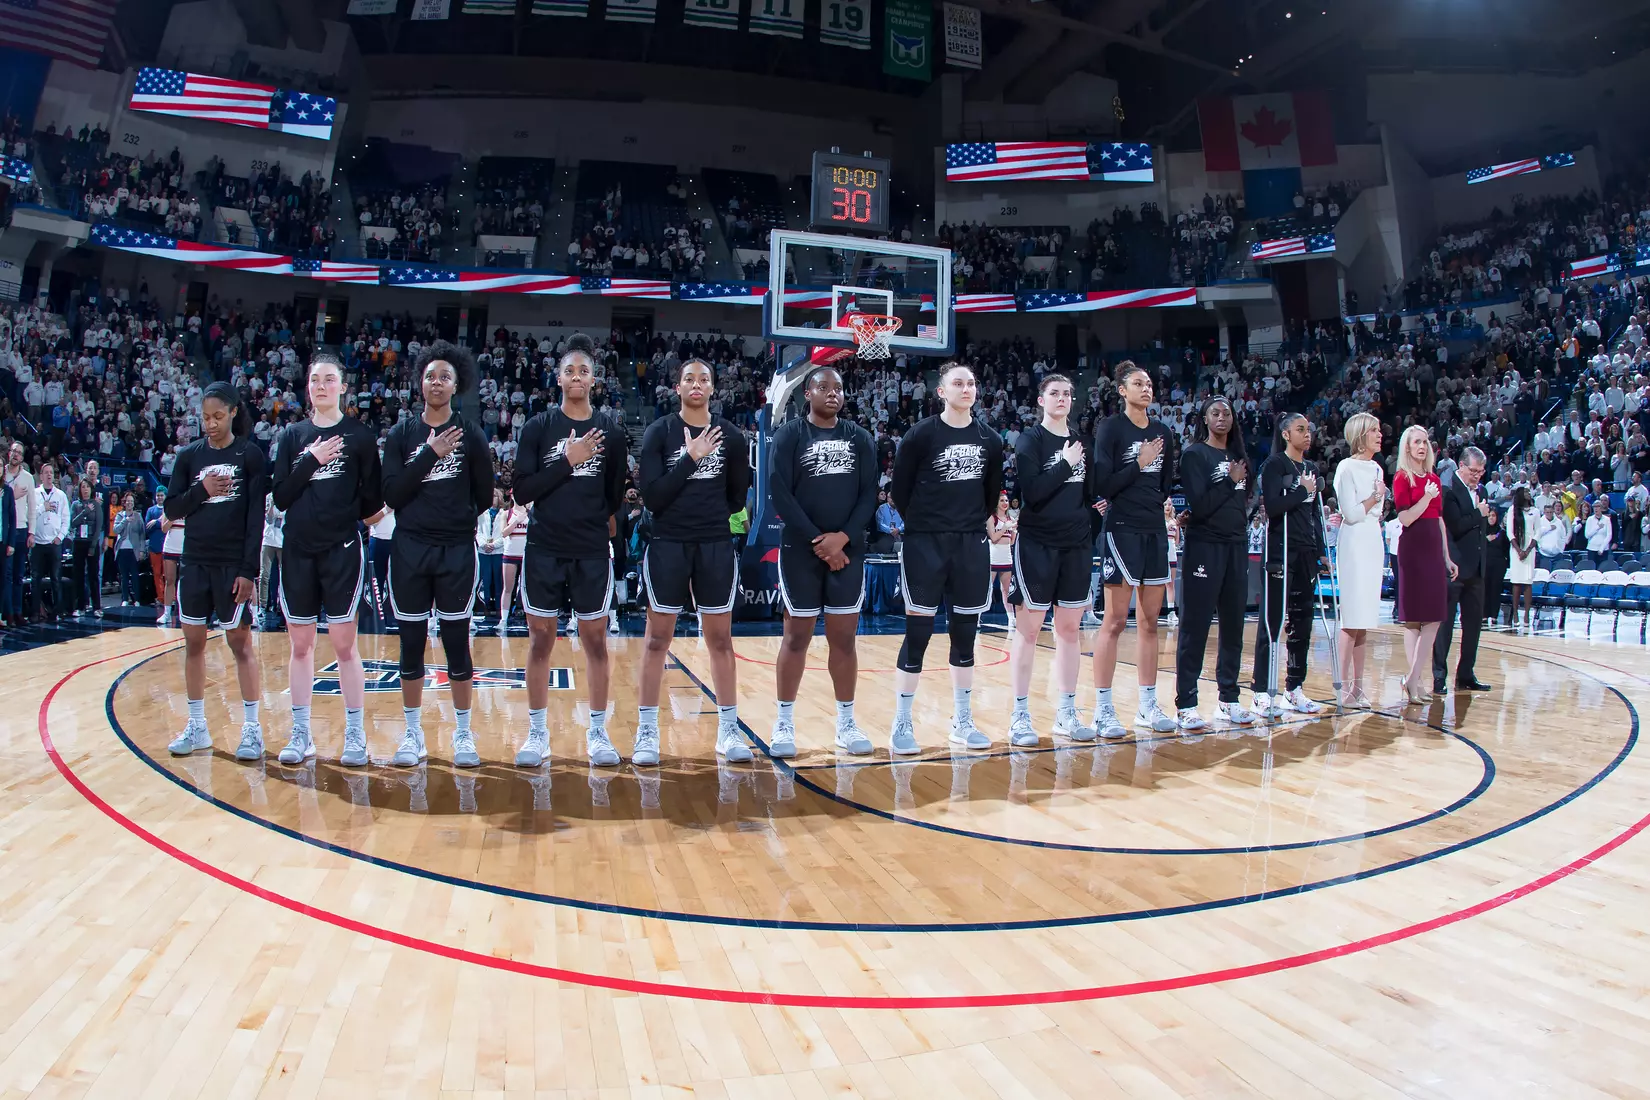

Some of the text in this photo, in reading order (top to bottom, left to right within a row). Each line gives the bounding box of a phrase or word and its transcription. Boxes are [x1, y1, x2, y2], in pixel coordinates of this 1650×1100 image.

[829, 3, 863, 31] 19
[123, 133, 140, 145] 232
[251, 160, 269, 170] 233
[833, 167, 877, 188] 10:00
[832, 187, 871, 223] 30
[1000, 207, 1018, 216] 239
[371, 577, 385, 620] UCONN
[744, 589, 780, 605] RAV
